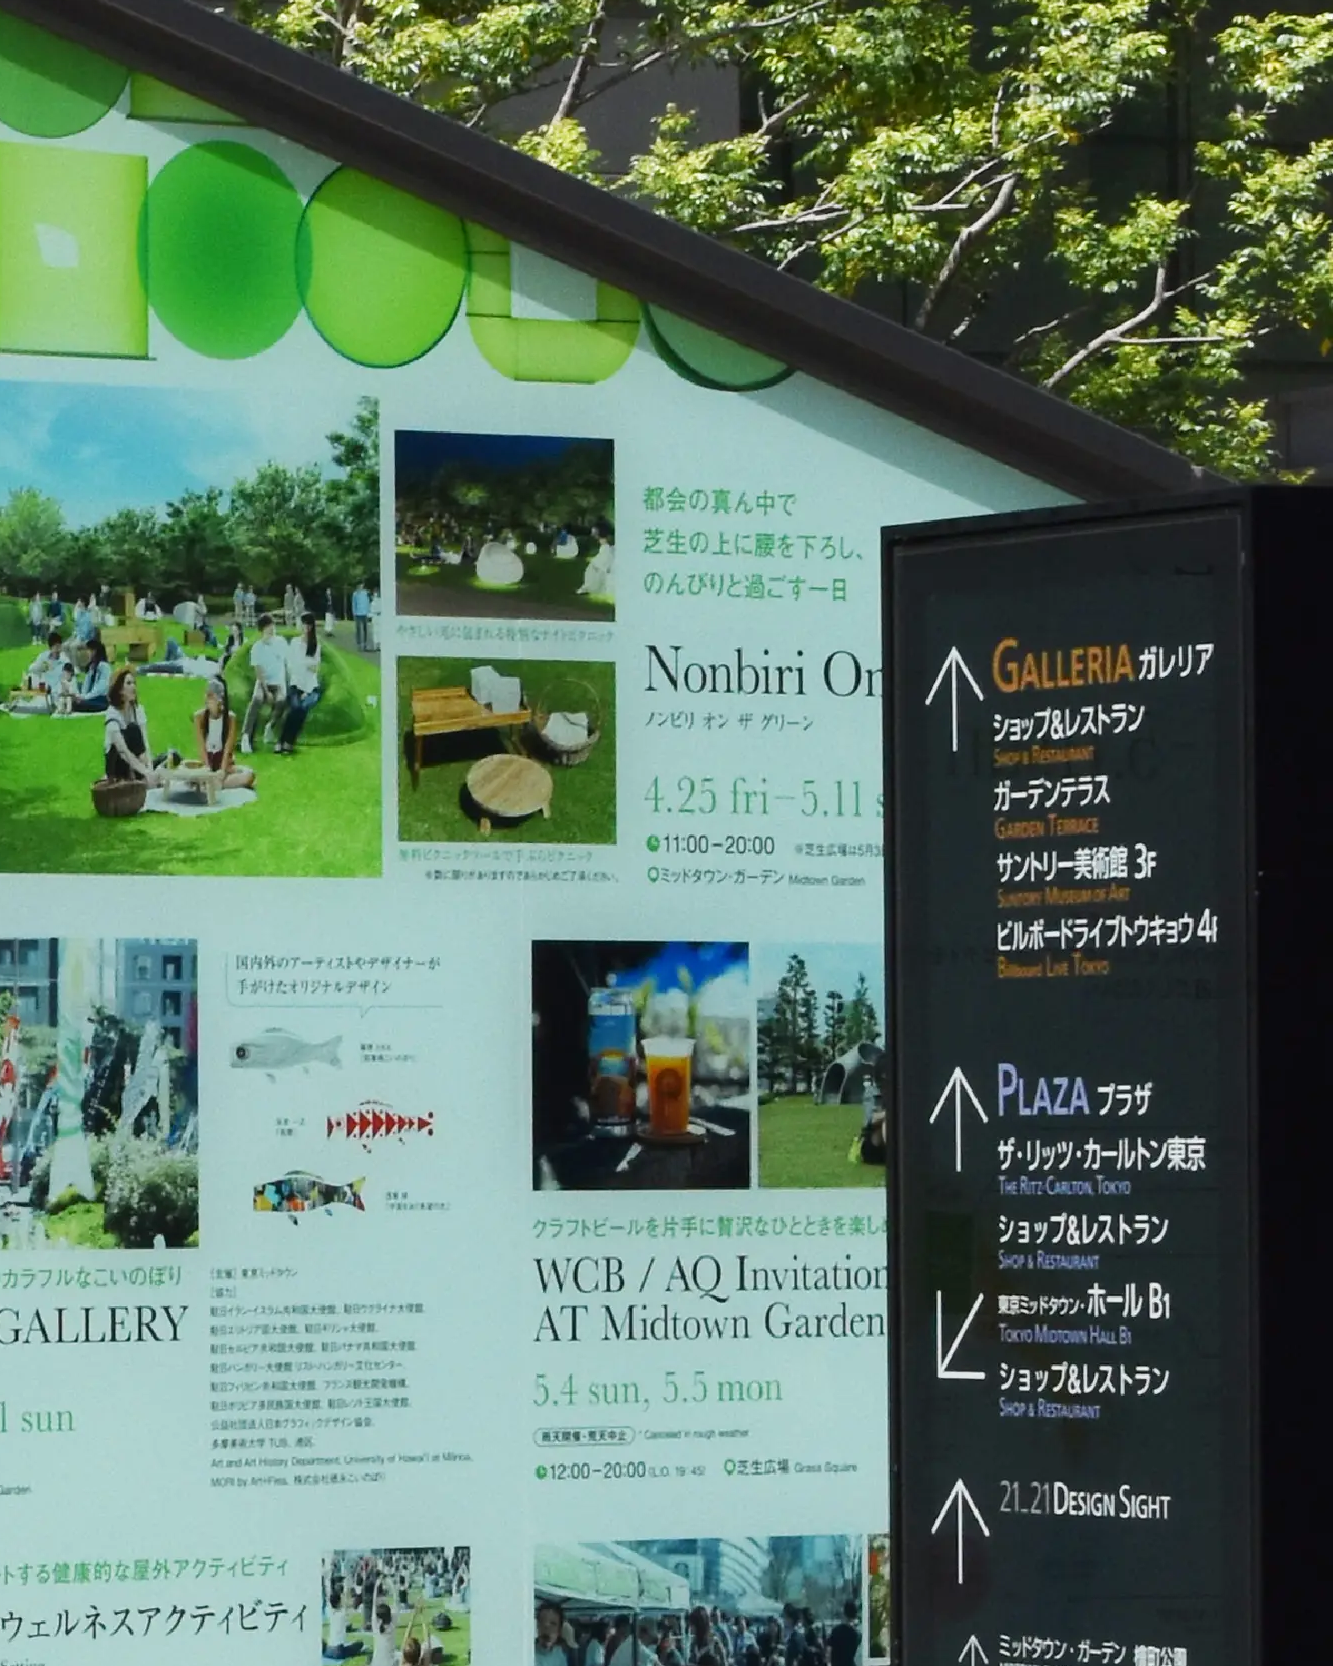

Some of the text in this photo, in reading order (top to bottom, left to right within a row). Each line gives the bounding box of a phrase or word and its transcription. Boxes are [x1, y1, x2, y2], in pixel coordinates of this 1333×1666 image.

[644, 486, 796, 516] 都会の真ん中で
[644, 528, 863, 560] 芝生の上に腰を下ろし、
[644, 572, 847, 602] のんびりと過ごす一日
[644, 644, 807, 696] Nonbiri
[993, 637, 1214, 693] GALLERIA ガレリア
[644, 711, 813, 731] ノンビリ オン ザ グリーン
[993, 703, 1145, 742] ショップ&レストラン
[644, 775, 717, 814] 4.25
[993, 775, 1110, 811] ガーデンテラス
[997, 843, 1157, 882] サントリー美術館 3F
[997, 912, 1194, 951] ビルボードライブトウキョウ
[998, 1062, 1152, 1117] PLAZA プラザ
[998, 1136, 1207, 1173] ザ・リッツ・カールトン東京
[1096, 1175, 1131, 1195] TOKYO
[998, 1213, 1169, 1246] ショップ&レストラン
[534, 1256, 625, 1294] WCB
[639, 1258, 655, 1294] /
[665, 1254, 730, 1304] AQ
[998, 1282, 1171, 1320] 東京ミッドタウン・ホール B1
[533, 1300, 885, 1343] AT Midtown Garden
[533, 1371, 783, 1412] 5.4 sun, 5.5 mon
[999, 1361, 1170, 1397] ショップ&レストラン
[21, 1408, 76, 1433] sun
[1053, 1481, 1115, 1517] DESIGN
[1120, 1485, 1170, 1521] SIGHT
[999, 1635, 1127, 1664] ミッドタウン・ガーデン
